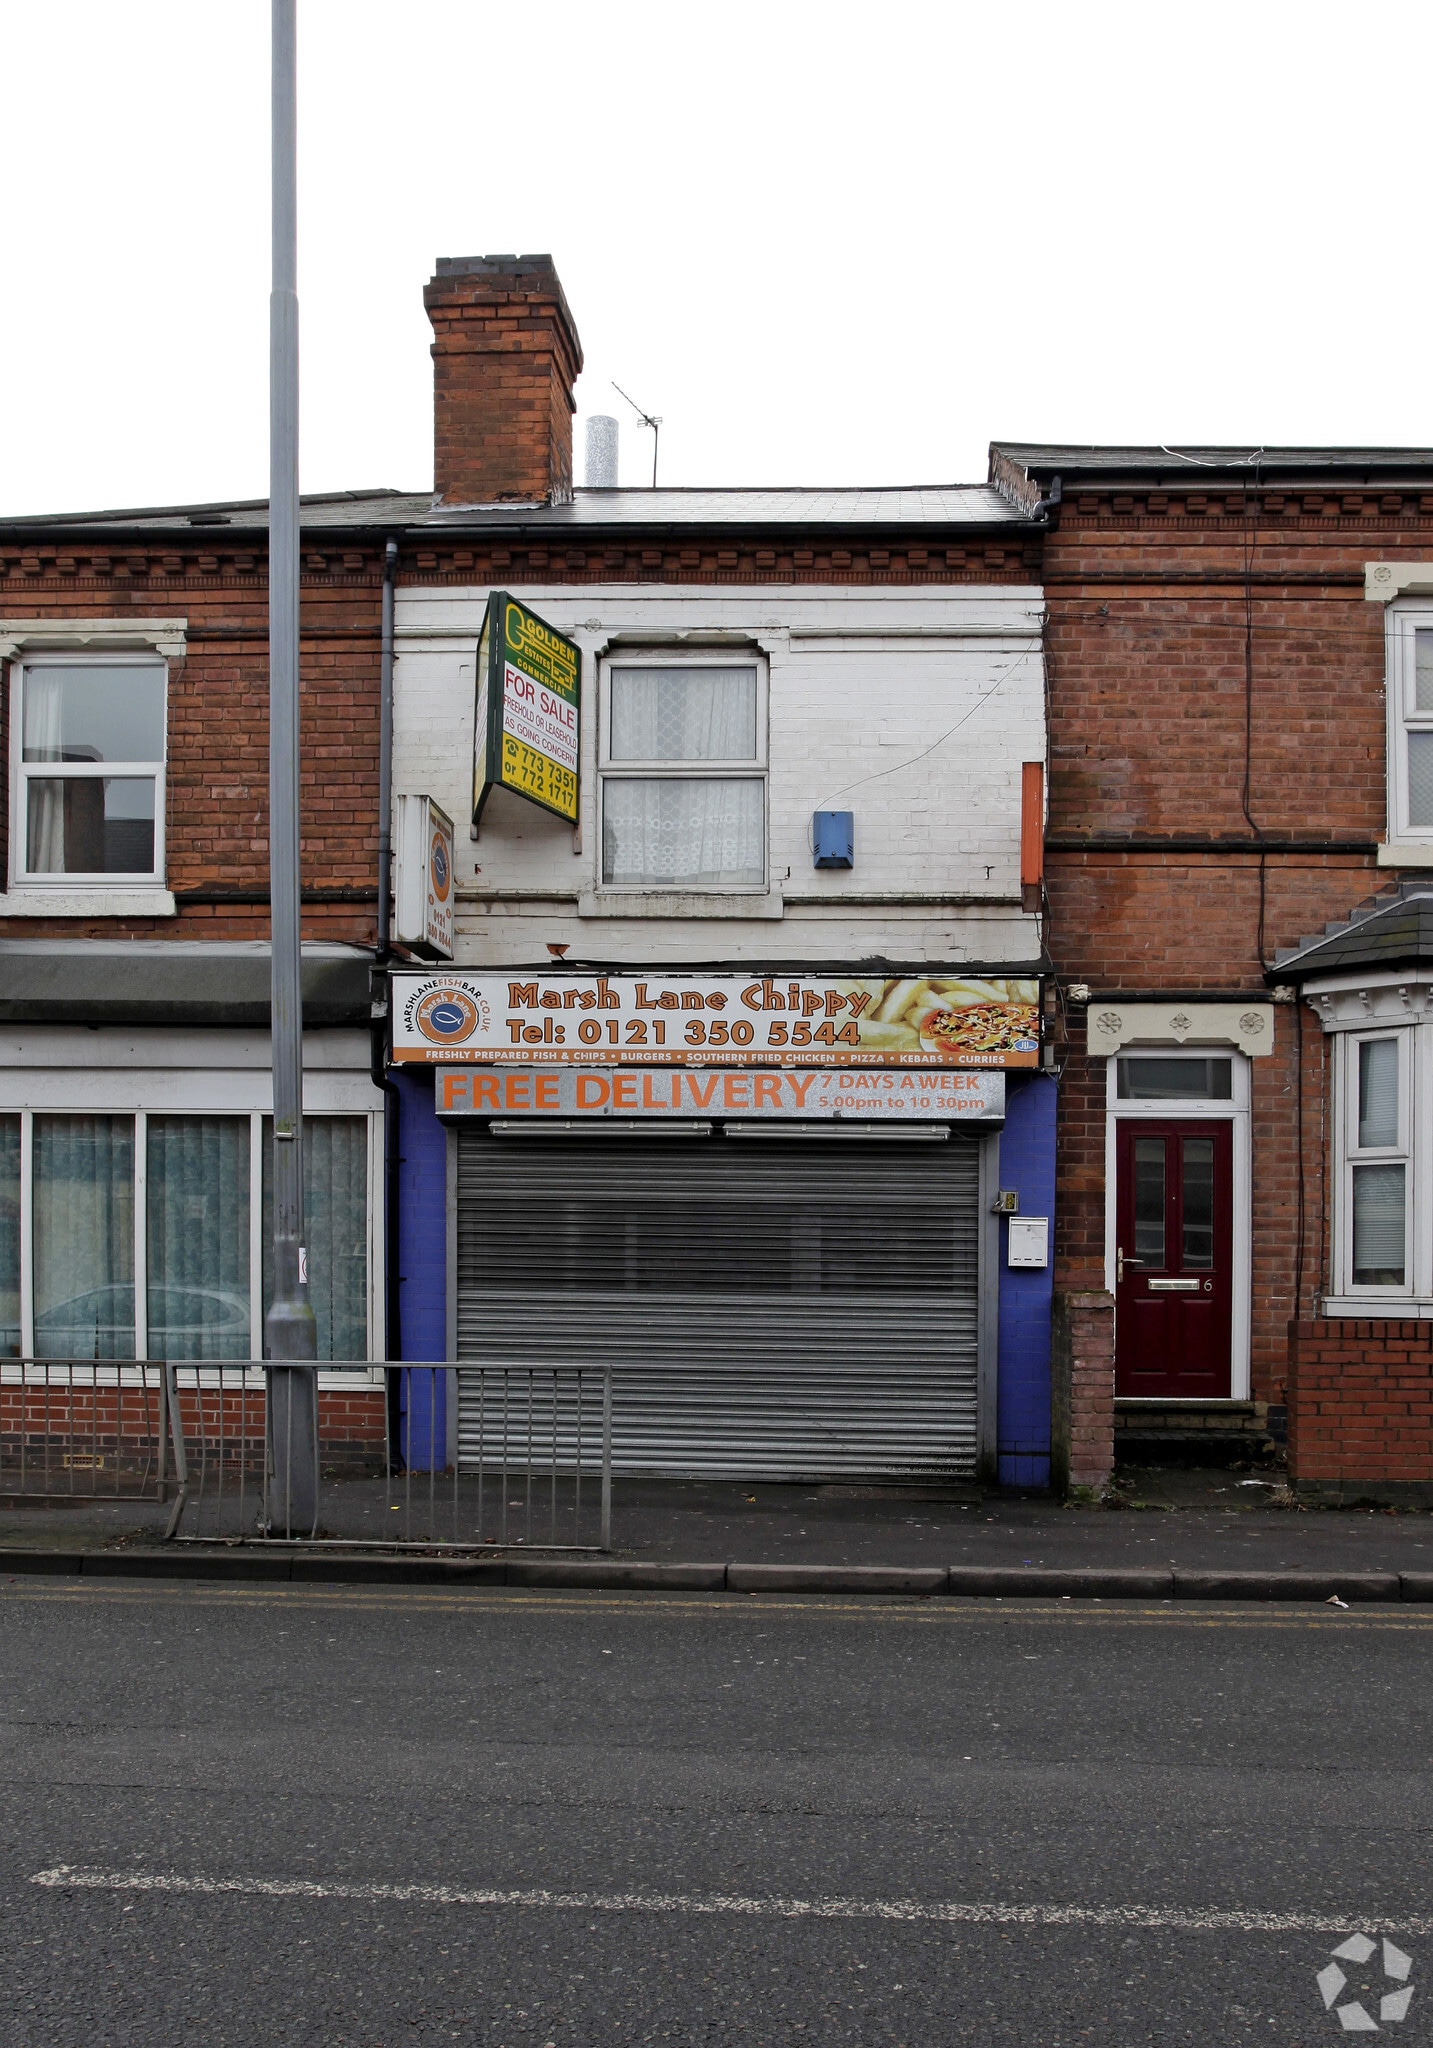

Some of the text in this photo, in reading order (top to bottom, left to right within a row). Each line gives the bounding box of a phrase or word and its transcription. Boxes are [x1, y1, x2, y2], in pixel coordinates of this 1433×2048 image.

[525, 645, 550, 670] ESTATES
[527, 619, 575, 664] GOLDEN
[517, 658, 566, 697] COMMERCIAL
[506, 668, 575, 731] FOR SALE
[504, 693, 577, 750] FREEHOLD OR LEASEHOLD
[505, 716, 575, 766] AS GOING CONCERN
[505, 761, 574, 808] or 772 1717
[522, 746, 575, 791] 773 7351
[404, 978, 491, 1033] MARSHLANEFISHBAR.CO.UK
[420, 993, 449, 1019] Marsh
[507, 978, 872, 1018] Marsh Lane Chippy
[506, 1017, 861, 1046] Tel: 0121 350 5544
[425, 1050, 1005, 1064] FRESHLY PREPARED FISH & CHIPS BURGERS SOUTHERN FRIED CHICKEN PIZZA KEBABS CURRIES
[443, 1073, 816, 1110] FREE DELIVERY
[821, 1074, 980, 1090] 7 DAYS A WEEK
[818, 1096, 883, 1110] 5.00pm
[887, 1097, 905, 1108] to
[1203, 1279, 1213, 1292] 6
